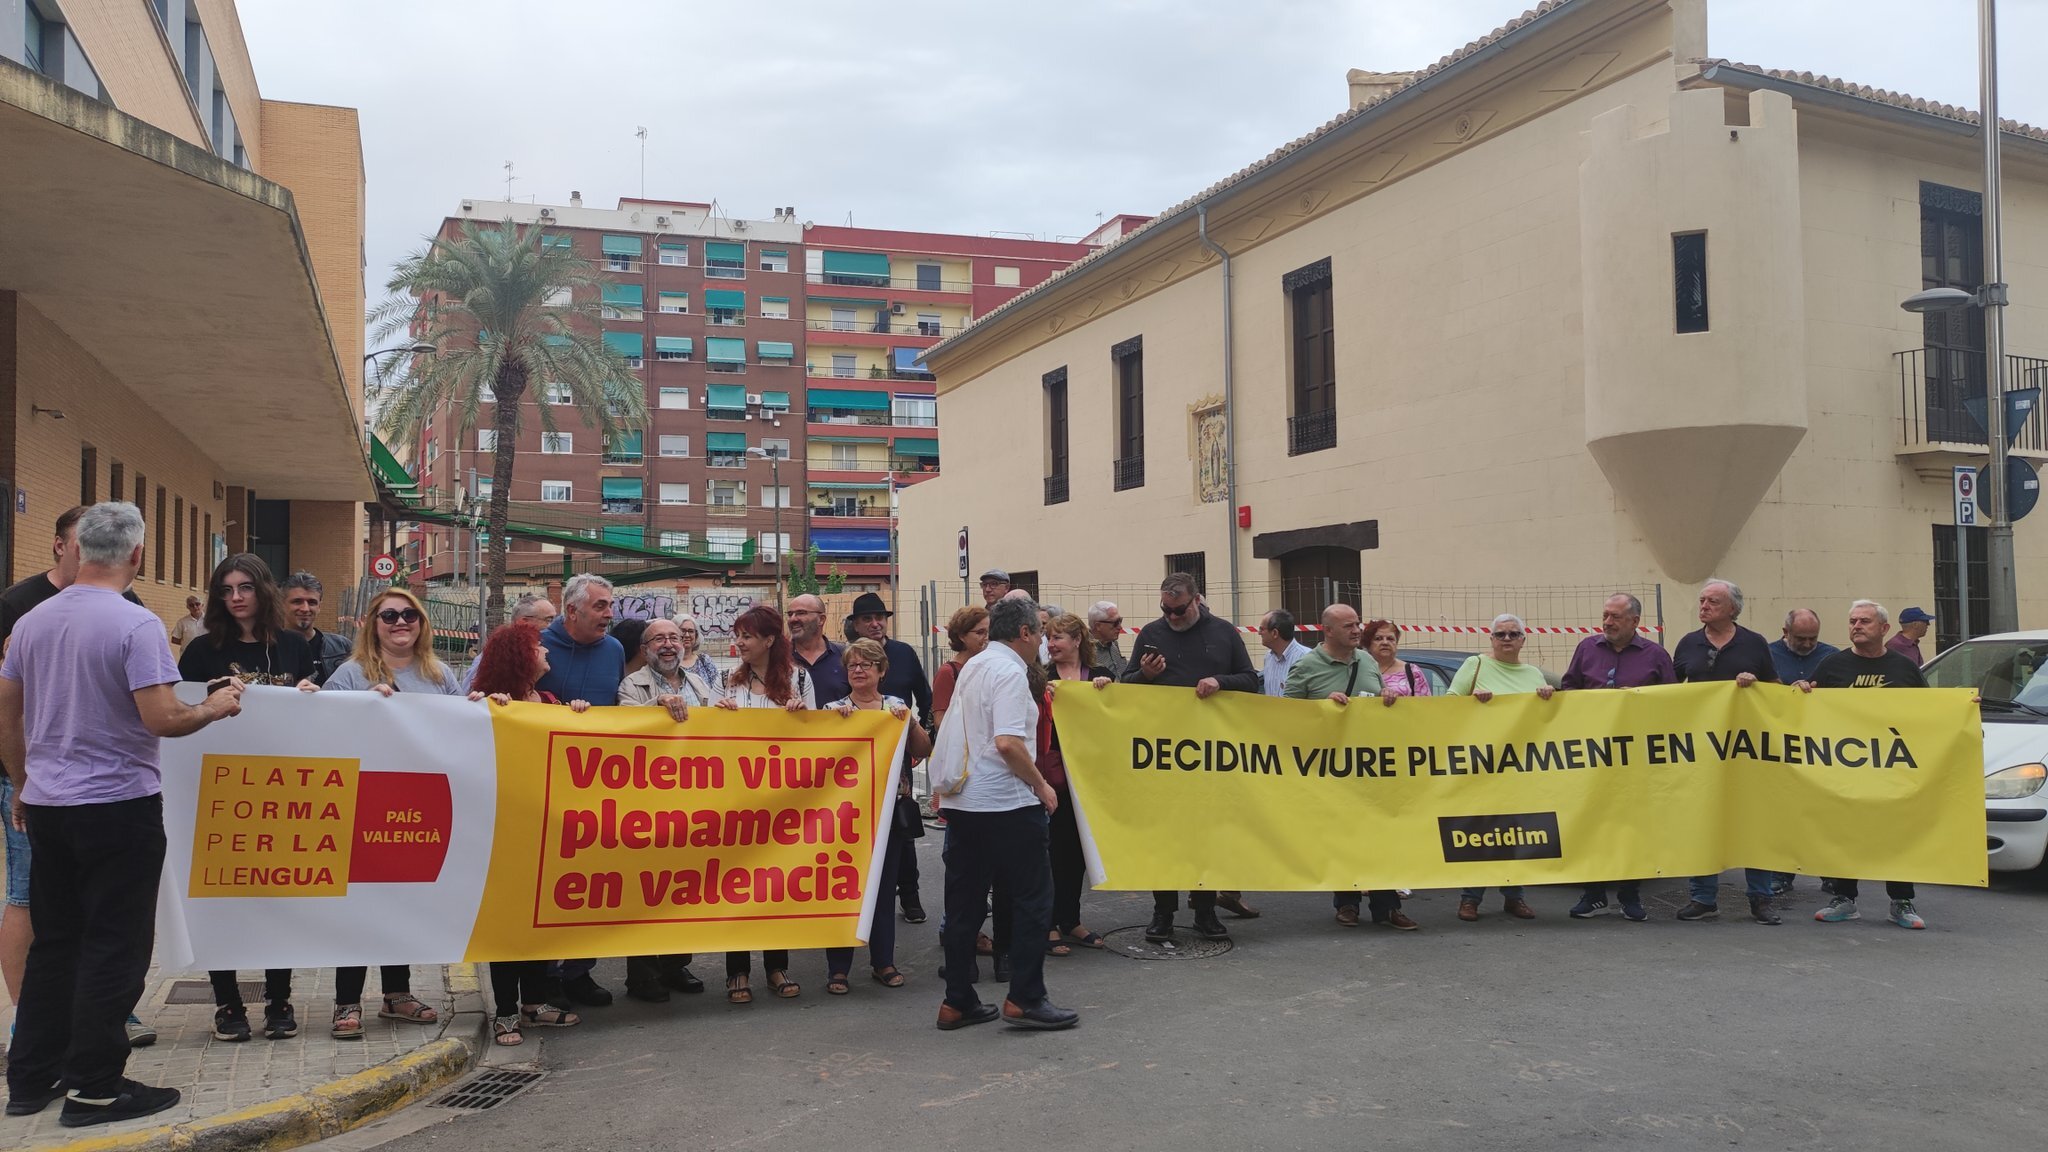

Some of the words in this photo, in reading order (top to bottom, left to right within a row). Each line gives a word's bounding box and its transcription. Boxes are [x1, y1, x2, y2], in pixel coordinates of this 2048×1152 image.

[1962, 503, 1971, 522] P
[378, 563, 392, 571] 30
[1855, 674, 1886, 687] NIKE
[1132, 737, 1283, 776] DECIDIM
[1292, 746, 1397, 778] VIURE
[1408, 735, 1634, 777] PLENAMENT
[1647, 732, 1696, 765] EN
[1706, 727, 1918, 769] VALENCIÀ
[566, 745, 725, 790] Volem
[738, 744, 859, 790] viure
[214, 767, 344, 787] PLATA
[211, 801, 340, 820] FORMA
[386, 808, 422, 824] PAÍS
[362, 828, 441, 844] VALENCIÀ
[560, 798, 860, 859] plenament
[1451, 827, 1548, 848] Decidim
[207, 833, 275, 853] PER
[292, 834, 338, 853] LA
[203, 867, 335, 886] LLENGUA
[553, 869, 623, 910] en
[639, 850, 861, 907] valencià
